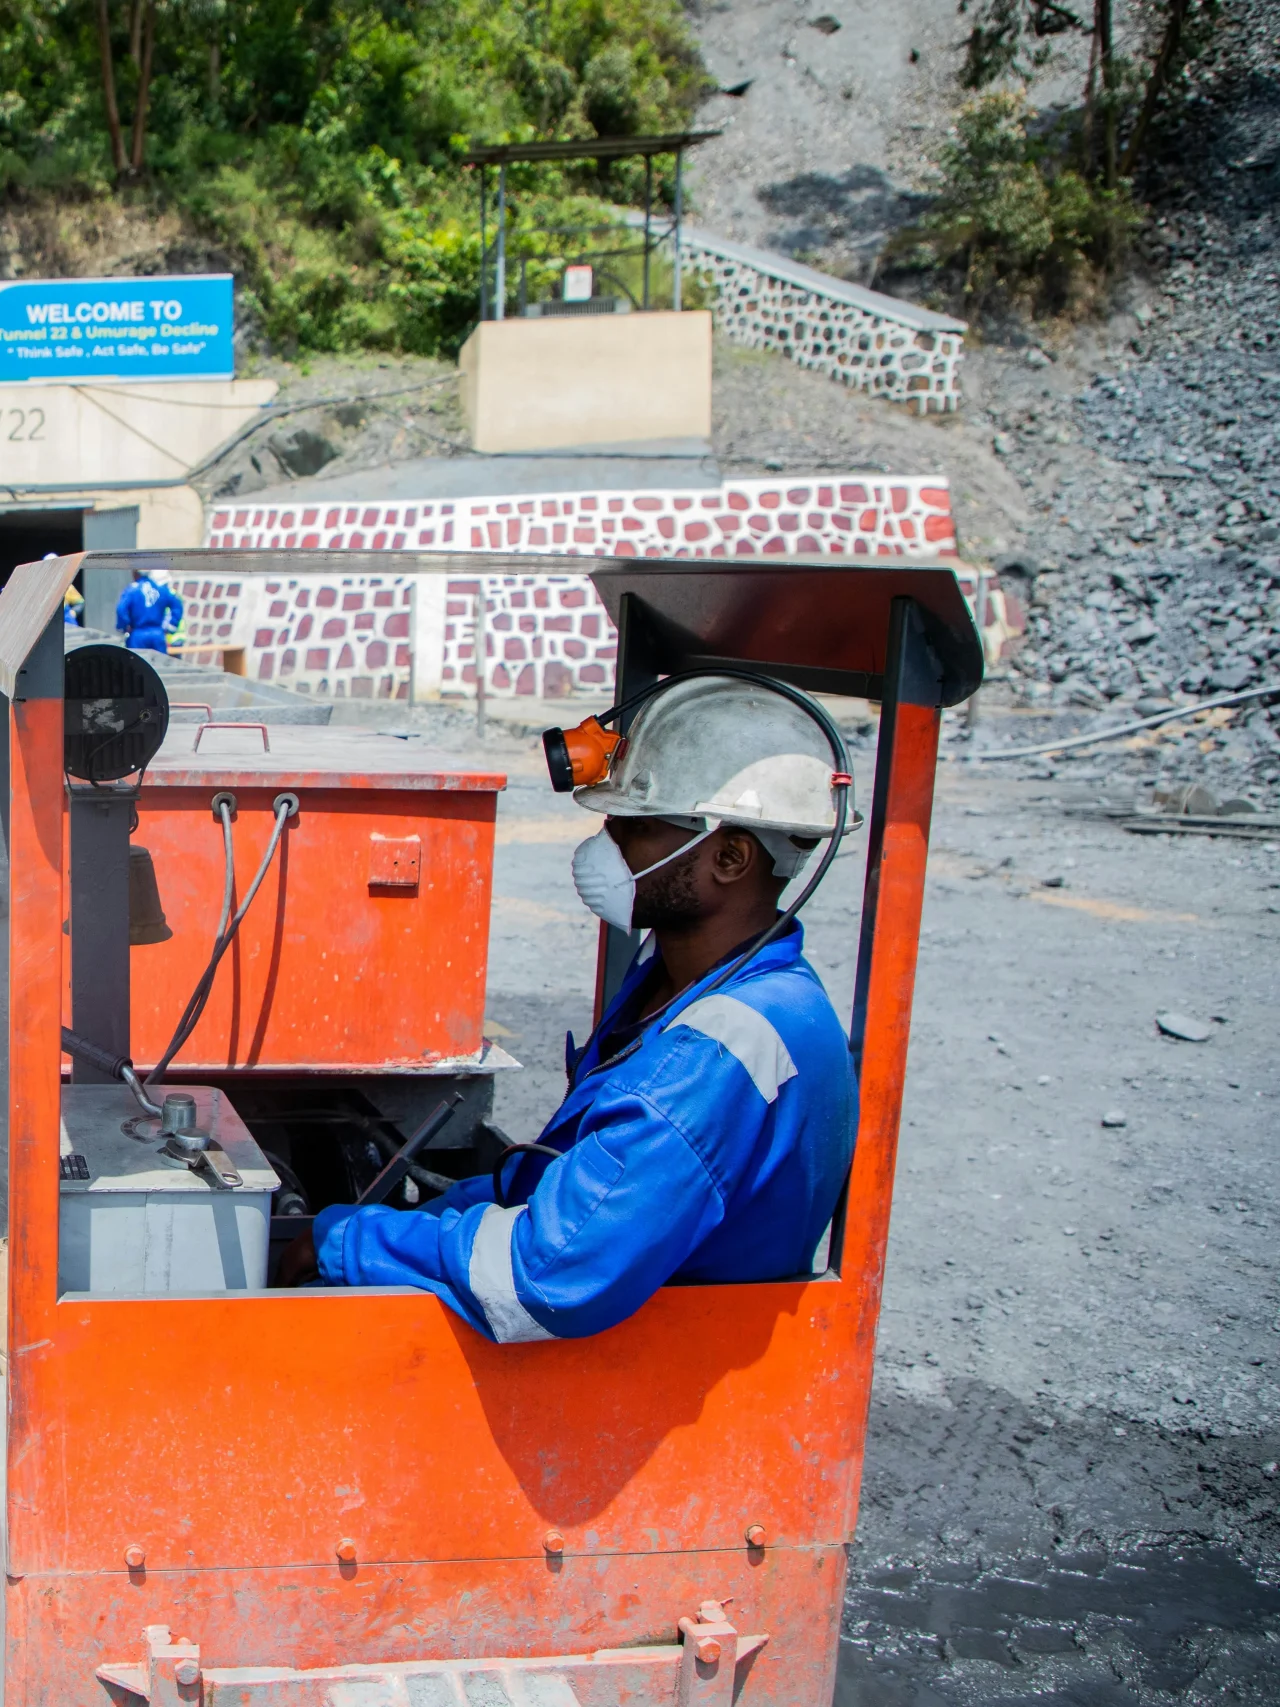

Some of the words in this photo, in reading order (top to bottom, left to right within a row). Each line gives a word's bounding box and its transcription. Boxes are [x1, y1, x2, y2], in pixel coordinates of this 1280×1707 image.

[26, 301, 145, 324] WELCOME
[149, 299, 183, 321] TO
[50, 326, 68, 340] 22
[71, 326, 82, 340] &
[85, 325, 157, 340] Umurage
[160, 322, 219, 337] Decline
[17, 346, 53, 358] Think
[151, 342, 170, 355] Be
